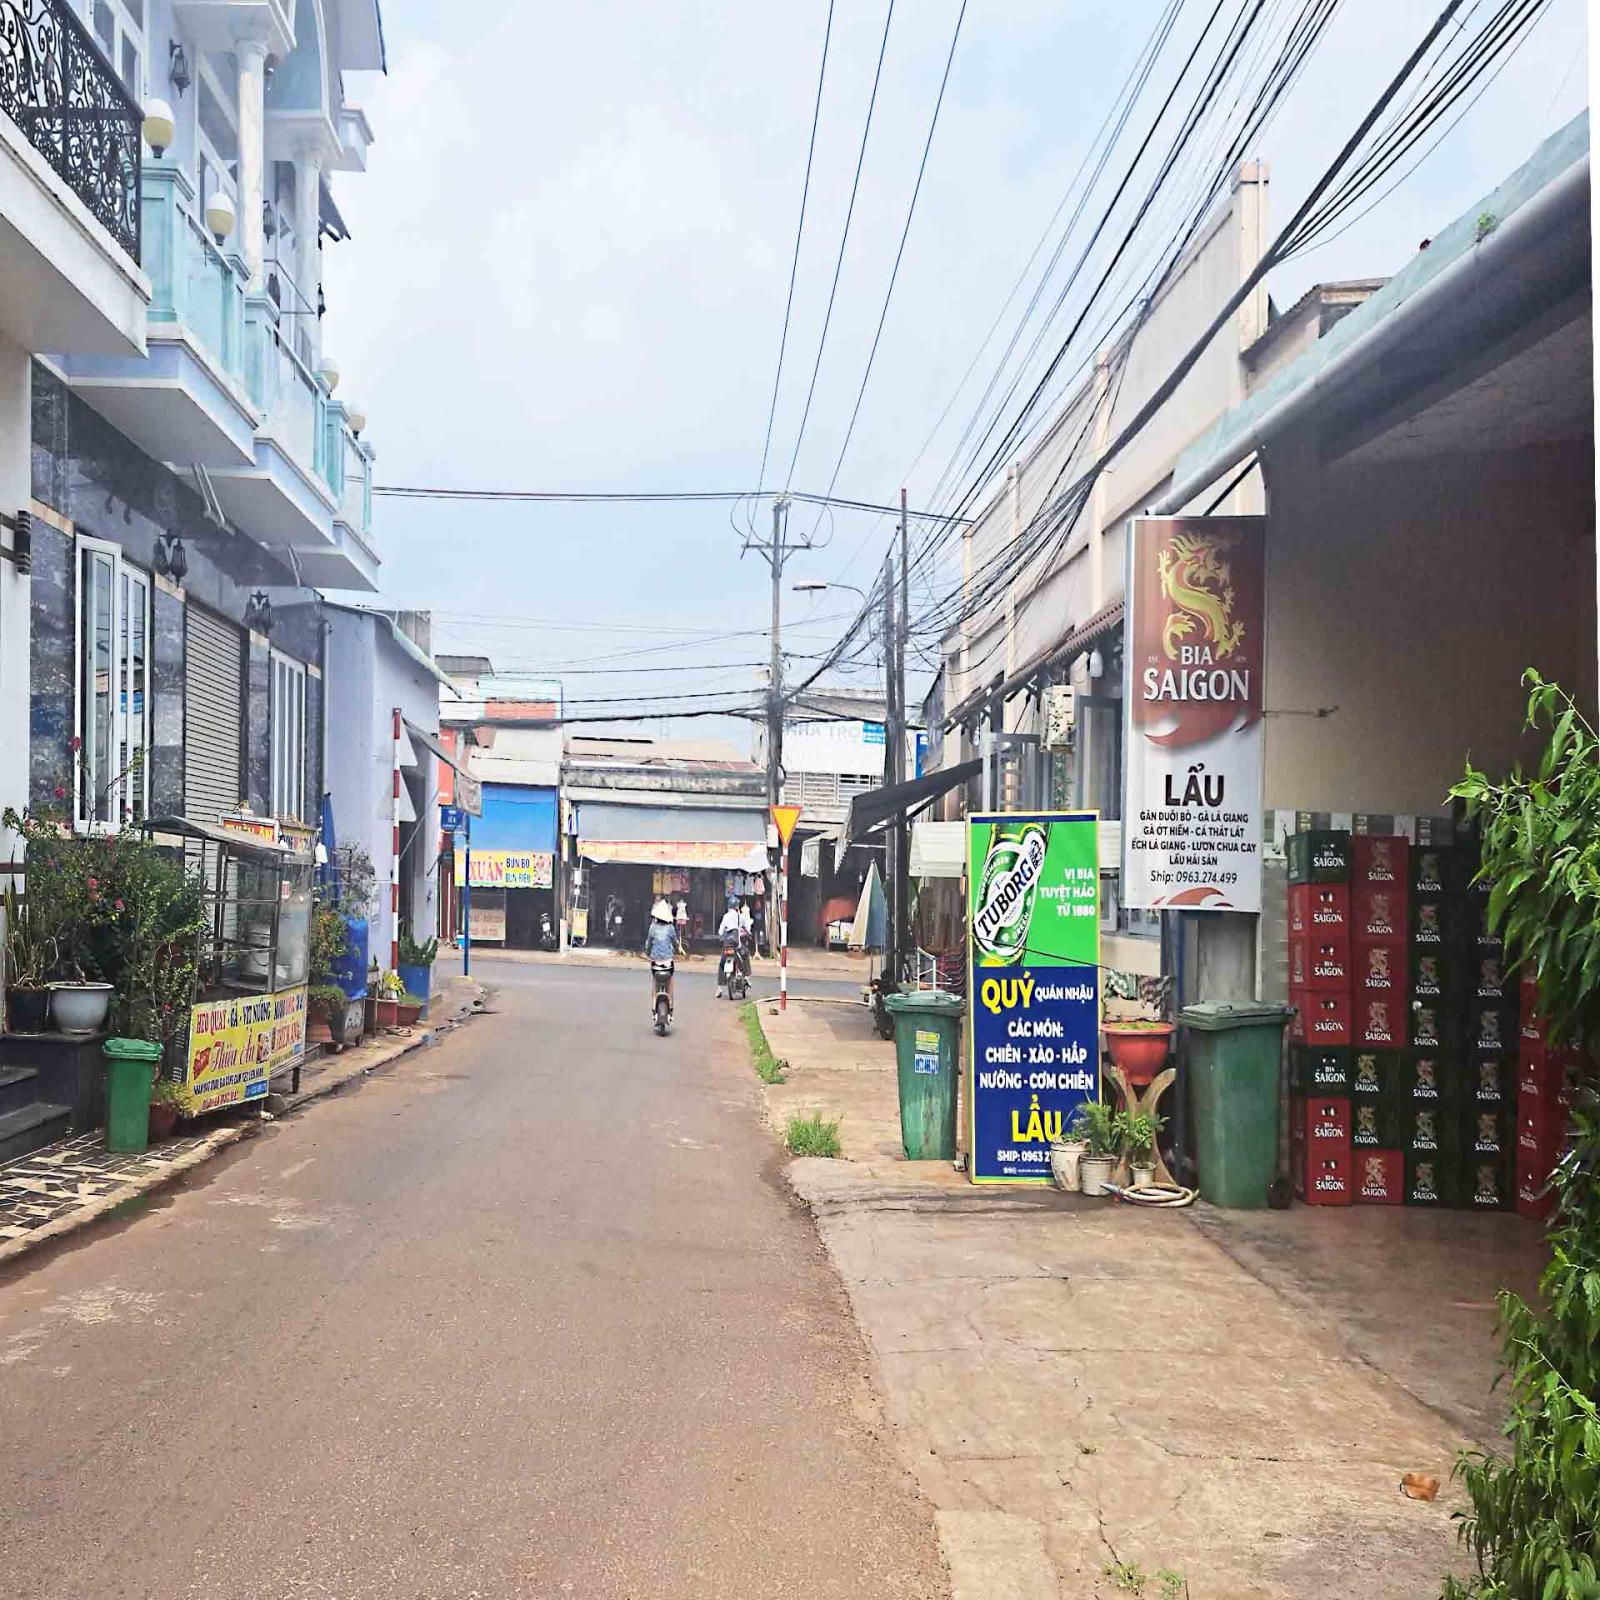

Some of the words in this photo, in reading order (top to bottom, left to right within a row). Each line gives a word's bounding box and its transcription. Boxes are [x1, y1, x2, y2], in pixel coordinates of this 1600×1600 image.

[1181, 645, 1214, 665] BIA
[1143, 667, 1250, 701] SAIGON
[1165, 762, 1225, 807] LẨU
[1180, 810, 1192, 821] BÒ
[1198, 812, 1210, 822] GÀ
[1211, 812, 1222, 822] LÁ
[1223, 813, 1249, 823] GIANG
[1143, 825, 1155, 836] GÀ
[1195, 826, 1207, 837] CÁ
[1148, 839, 1159, 850] LÁ
[1160, 840, 1186, 851] GIANG
[1216, 842, 1240, 852] CHUA
[1241, 842, 1258, 853] CAY
[1313, 857, 1345, 867] SAIGON
[1064, 868, 1075, 884] VỊ
[1077, 868, 1095, 880] BIA
[1150, 870, 1174, 885] Ship:
[1176, 871, 1238, 885] 0963.274.499
[1368, 872, 1394, 881] SAIGON
[1416, 882, 1441, 891] SAIGON
[1040, 884, 1071, 902] TUYỆT
[1073, 881, 1095, 898] HẢO
[978, 859, 1034, 937] TUBORG
[1313, 914, 1343, 923] SAIGON
[1367, 925, 1393, 933] SAIGON
[1416, 934, 1441, 942] SAIGON
[1314, 967, 1343, 976] SAIGON
[1365, 979, 1391, 987] SAIGON
[981, 971, 1035, 1014] QUÝ
[1034, 984, 1064, 1000] QUÁN
[1064, 984, 1094, 1003] NHẬU
[1415, 986, 1440, 994] SAIGON
[1007, 1017, 1032, 1038] CÁC
[1033, 1017, 1064, 1038] MÓN:
[1315, 1022, 1344, 1031] SAIGON
[1365, 1032, 1391, 1041] SAIGON
[1414, 1037, 1438, 1046] SAIGON
[1477, 1040, 1502, 1048] SAIGON
[985, 1043, 1021, 1064] CHIÊN
[1029, 1043, 1055, 1063] XÀO
[1062, 1041, 1087, 1064] HẤP
[979, 1068, 1022, 1090] NƯỚNG
[1029, 1072, 1056, 1090] CƠM
[1057, 1069, 1094, 1090] CHIÊN
[1314, 1072, 1346, 1082] SAIGON
[1354, 1083, 1379, 1092] SAIGON
[1413, 1089, 1438, 1098] SAIGON
[1476, 1091, 1500, 1100] SAIGON
[1011, 1094, 1062, 1143] LẨU
[1314, 1128, 1343, 1137] SAIGON
[1354, 1135, 1379, 1144] SAIGON
[1413, 1140, 1438, 1149] SAIGON
[1475, 1143, 1500, 1152] SAIGON
[997, 1150, 1020, 1162] SHIP:
[1021, 1150, 1043, 1162] 0963
[1315, 1181, 1344, 1190] SAIGON
[1361, 1187, 1387, 1197] SAIGON
[1413, 1191, 1438, 1201] SAIGON
[1474, 1195, 1499, 1204] SAIGON
